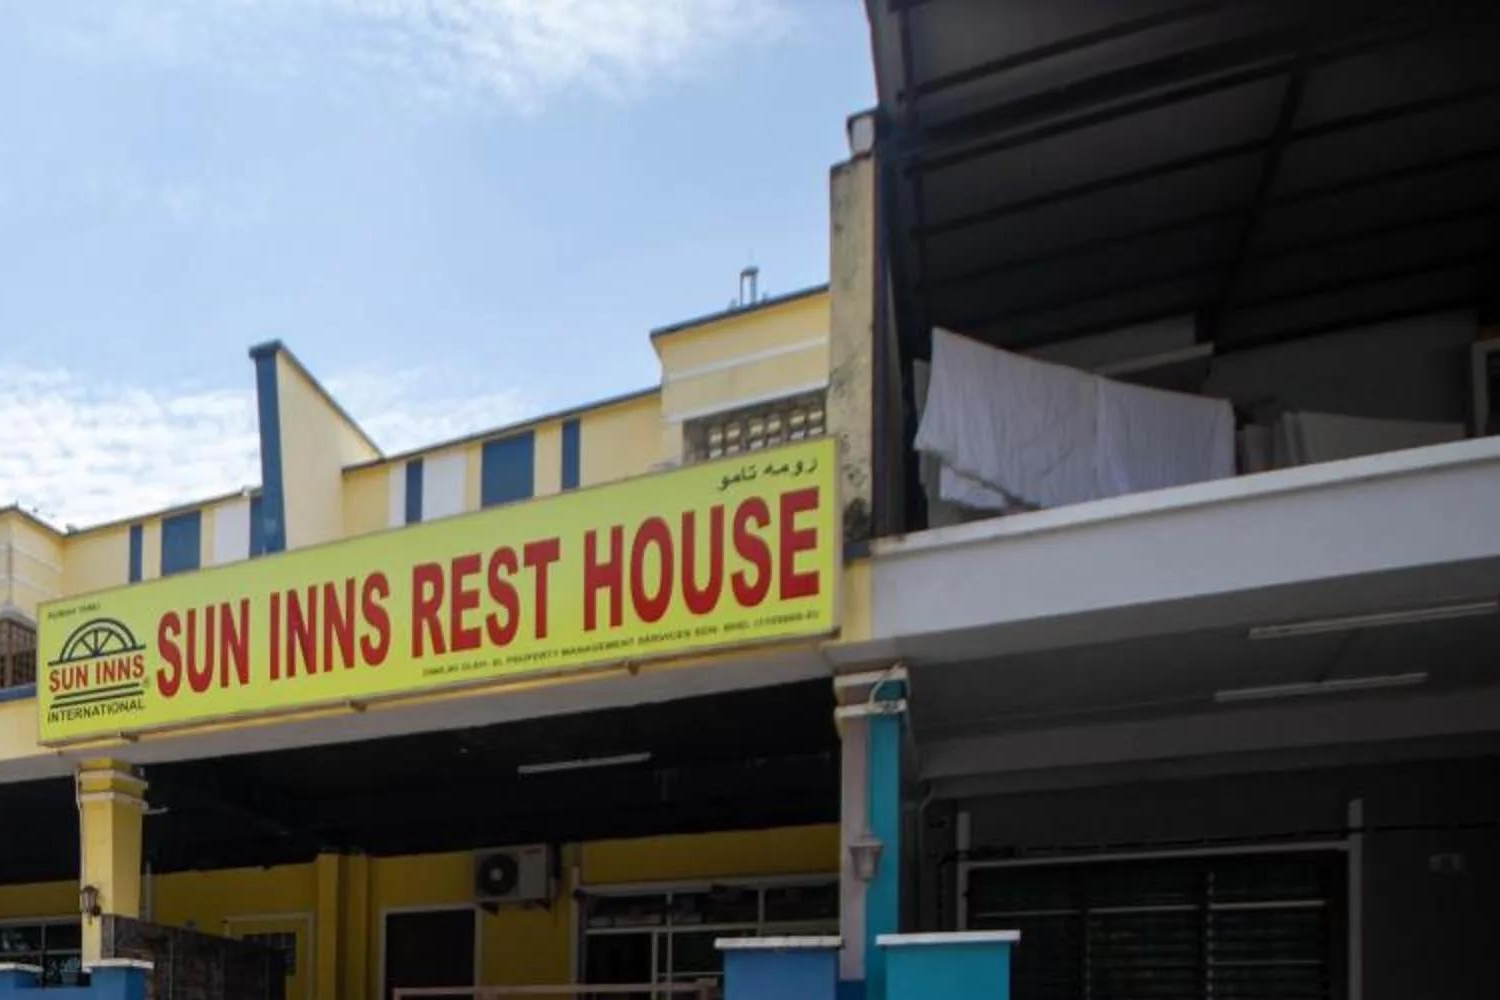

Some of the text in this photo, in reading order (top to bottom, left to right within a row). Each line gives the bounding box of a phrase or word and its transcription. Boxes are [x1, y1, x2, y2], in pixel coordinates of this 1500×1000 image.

[156, 486, 820, 698] SUN INNS REST HOUSE
[506, 649, 558, 664] PROPERTY
[561, 637, 635, 657] MANAGEMENT
[638, 628, 691, 645] SERVICES
[48, 653, 145, 694] SUN INNS
[47, 698, 146, 723] INTERNATIONAL
